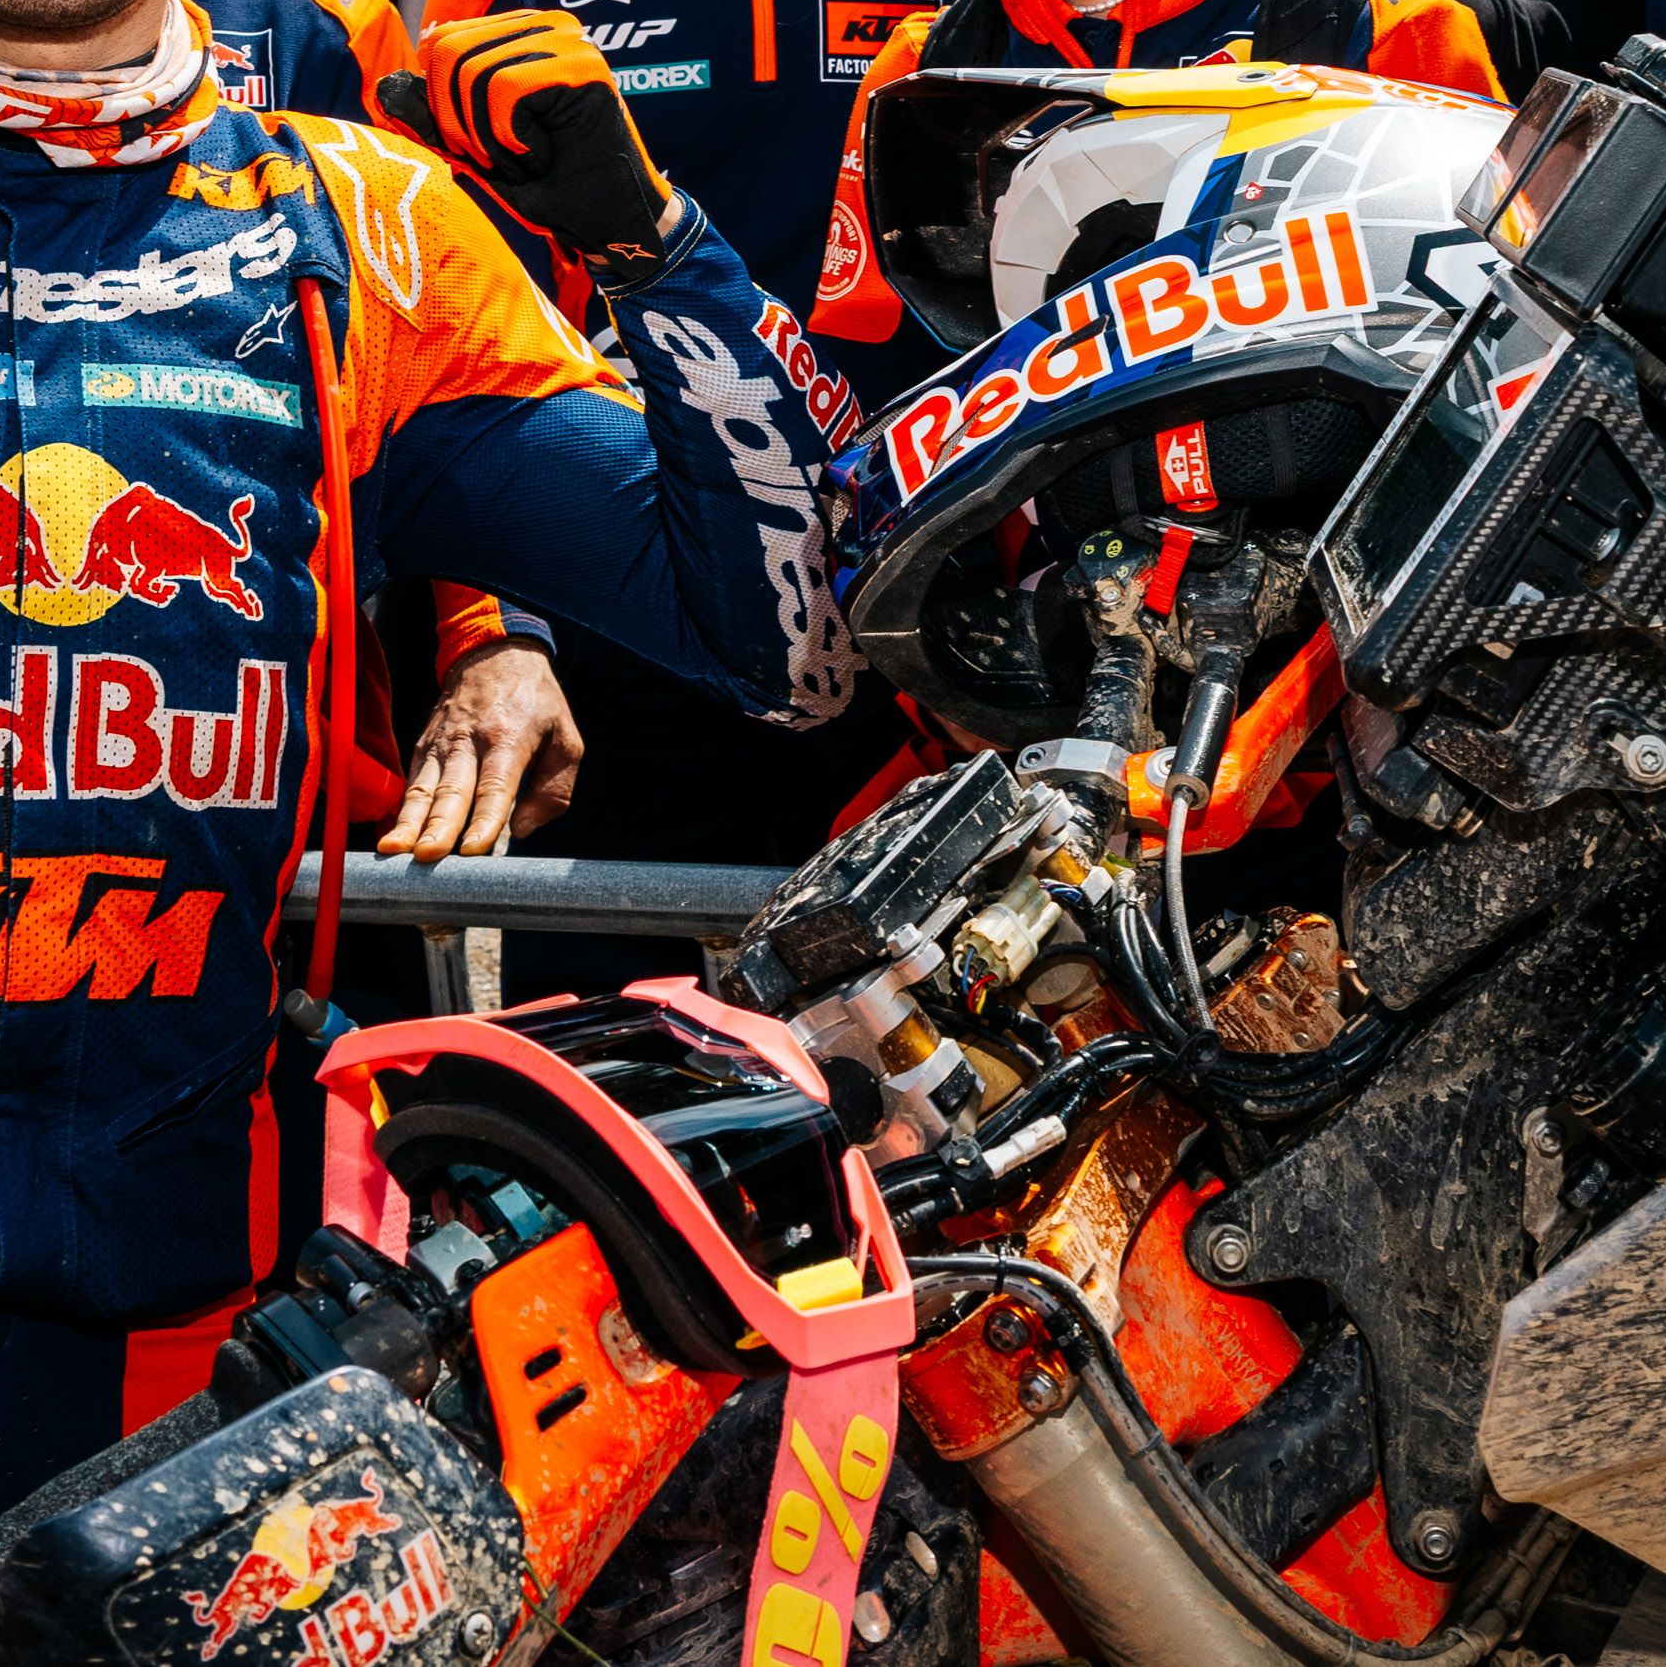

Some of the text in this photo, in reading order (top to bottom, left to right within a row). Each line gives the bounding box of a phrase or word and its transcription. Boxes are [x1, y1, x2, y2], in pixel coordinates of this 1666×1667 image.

[828, 58, 875, 74] FACTO
[167, 152, 317, 211] KTM
[140, 370, 294, 420] MOTOREX
[754, 298, 851, 432] Red
[886, 206, 1376, 506] Red Bull
[1187, 429, 1209, 495] PULL
[67, 653, 287, 810] Bull
[324, 1527, 455, 1667] Bull
